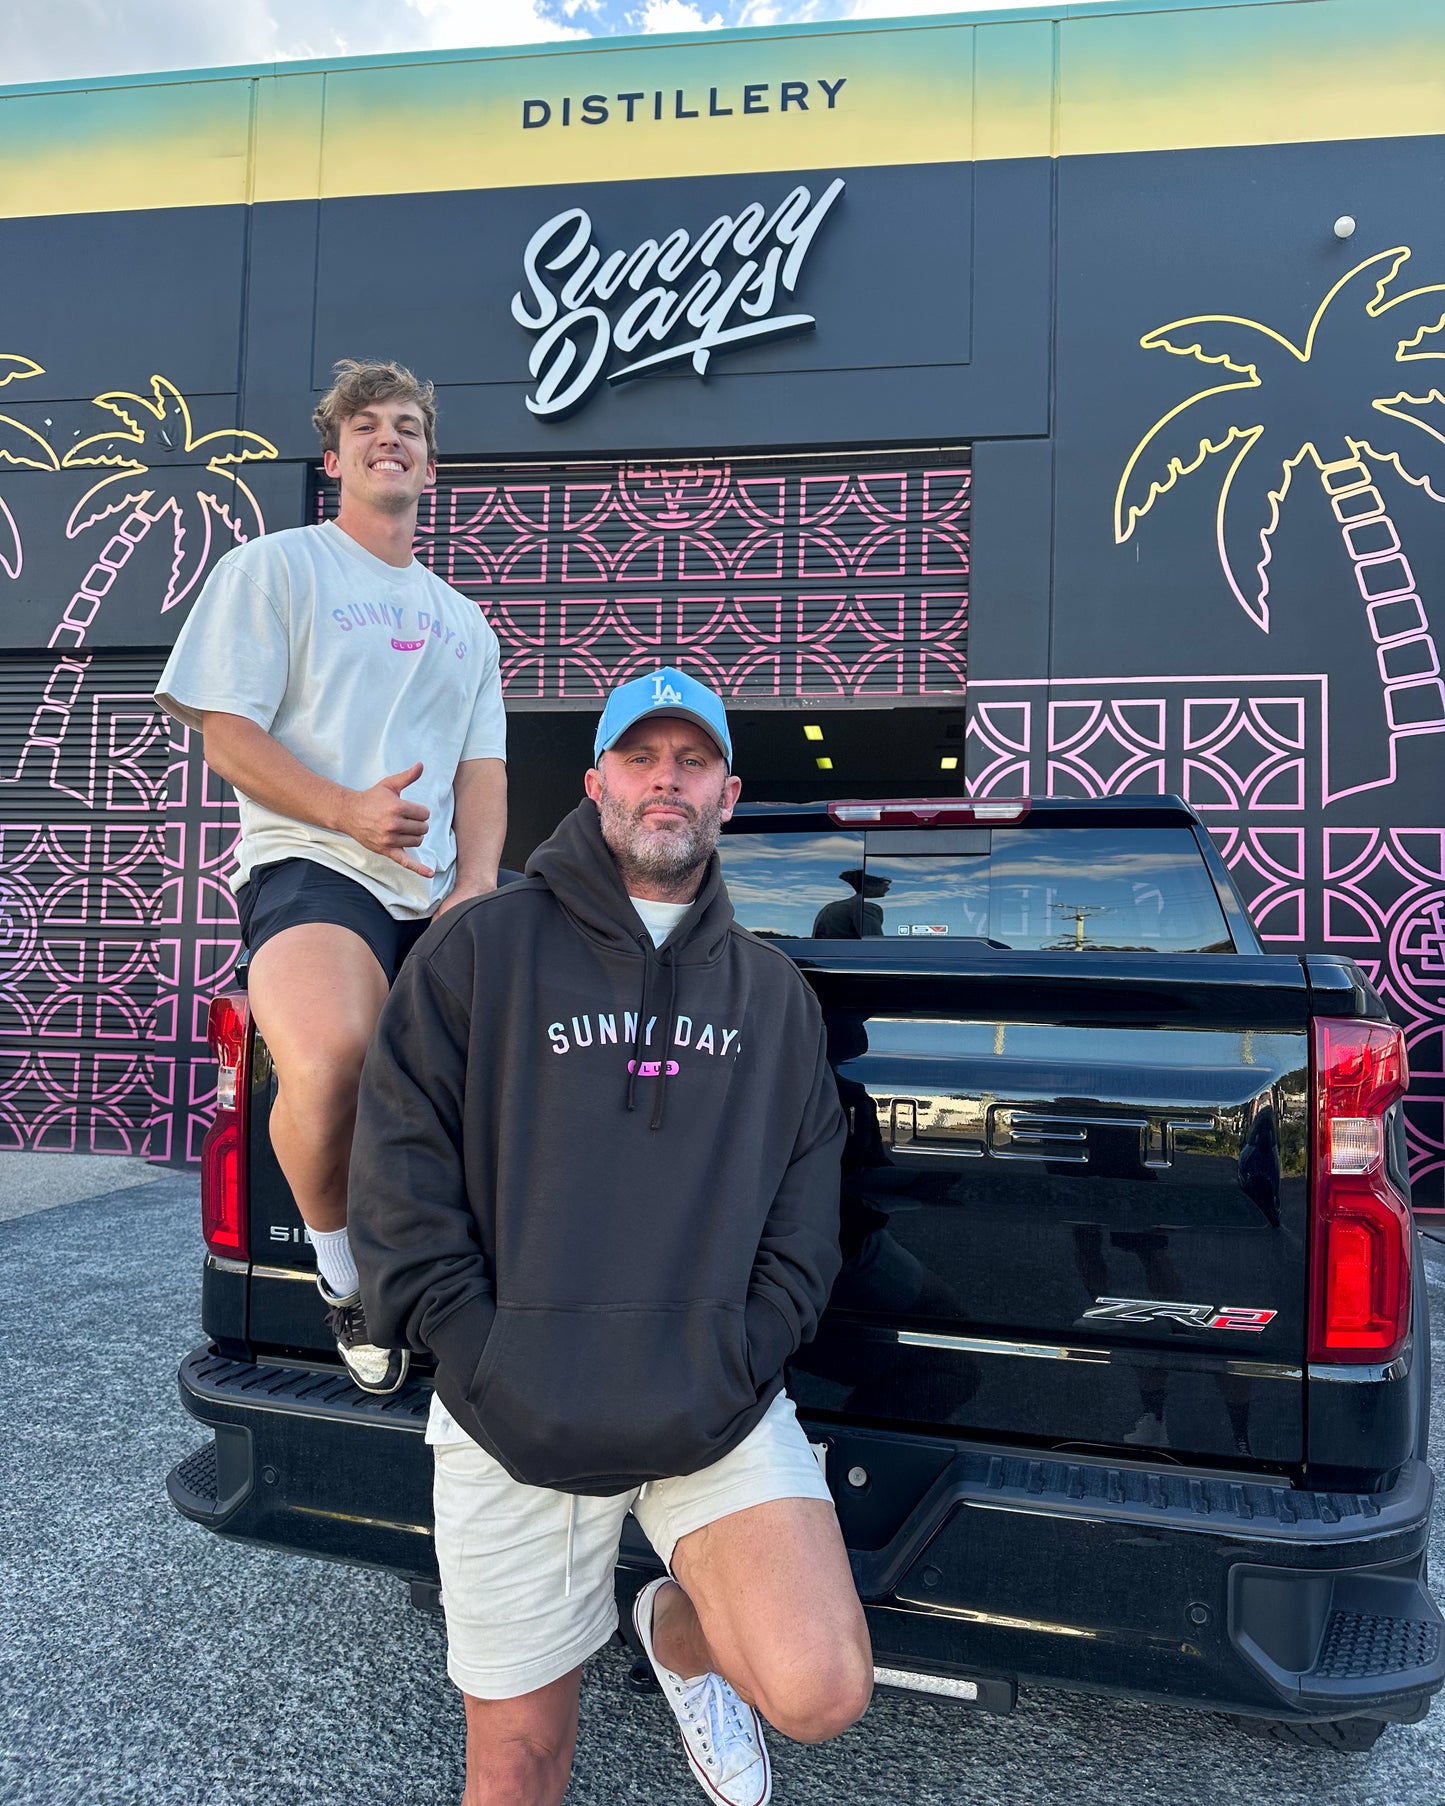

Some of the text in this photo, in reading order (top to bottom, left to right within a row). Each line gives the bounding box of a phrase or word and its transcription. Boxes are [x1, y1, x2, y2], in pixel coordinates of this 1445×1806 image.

[523, 78, 847, 129] DISTILLERY
[511, 177, 846, 330] Sunny
[525, 247, 816, 415] Days
[332, 602, 467, 660] SUNNY DAYS
[393, 640, 422, 650] CLUB
[651, 675, 683, 705] LA
[547, 1011, 742, 1063] SUNNY DAY
[633, 1063, 673, 1074] LUB
[1082, 1296, 1278, 1332] ZR2
